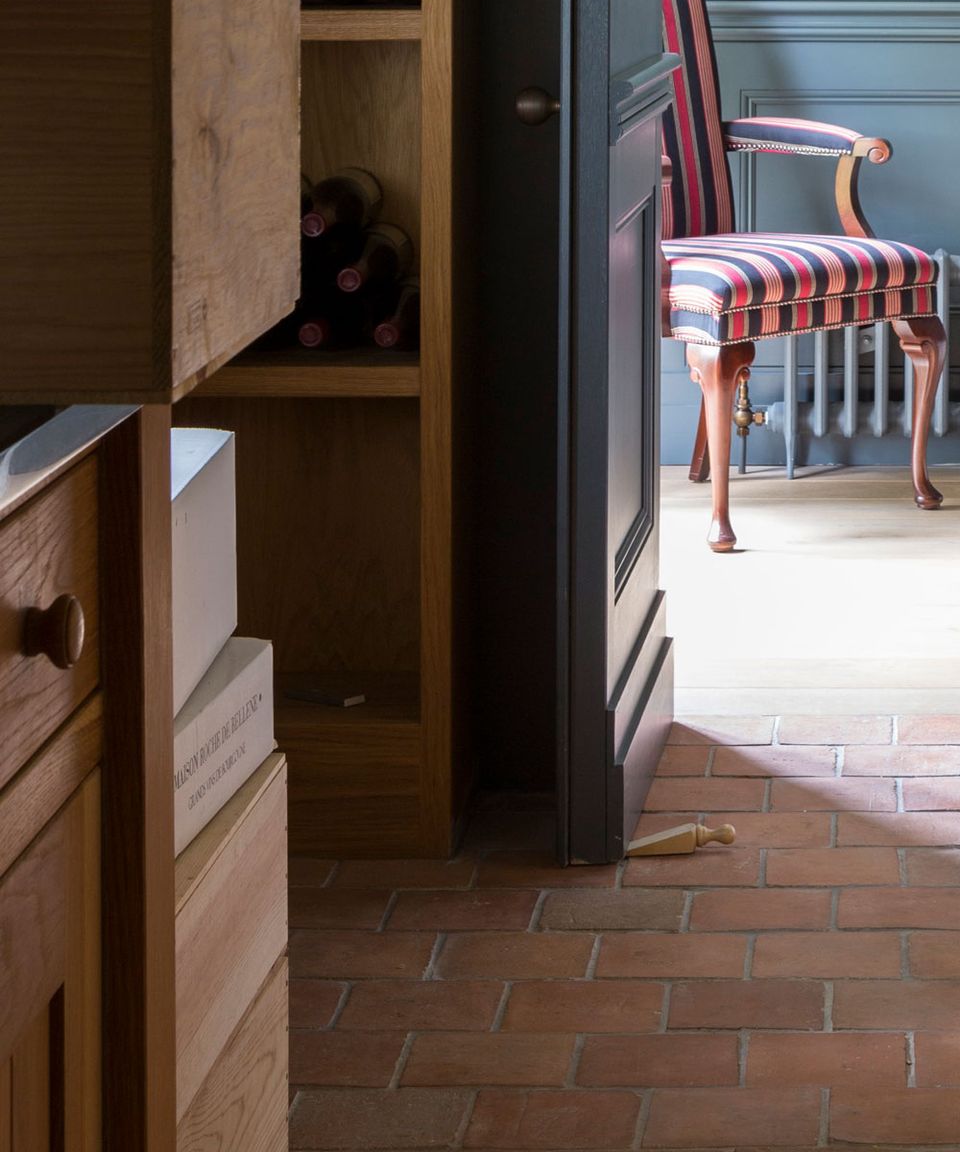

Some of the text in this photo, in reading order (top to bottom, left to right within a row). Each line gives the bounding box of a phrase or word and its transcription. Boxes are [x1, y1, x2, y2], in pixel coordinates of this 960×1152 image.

[174, 694, 257, 789] MAISON ROCHE DE BELLENE
